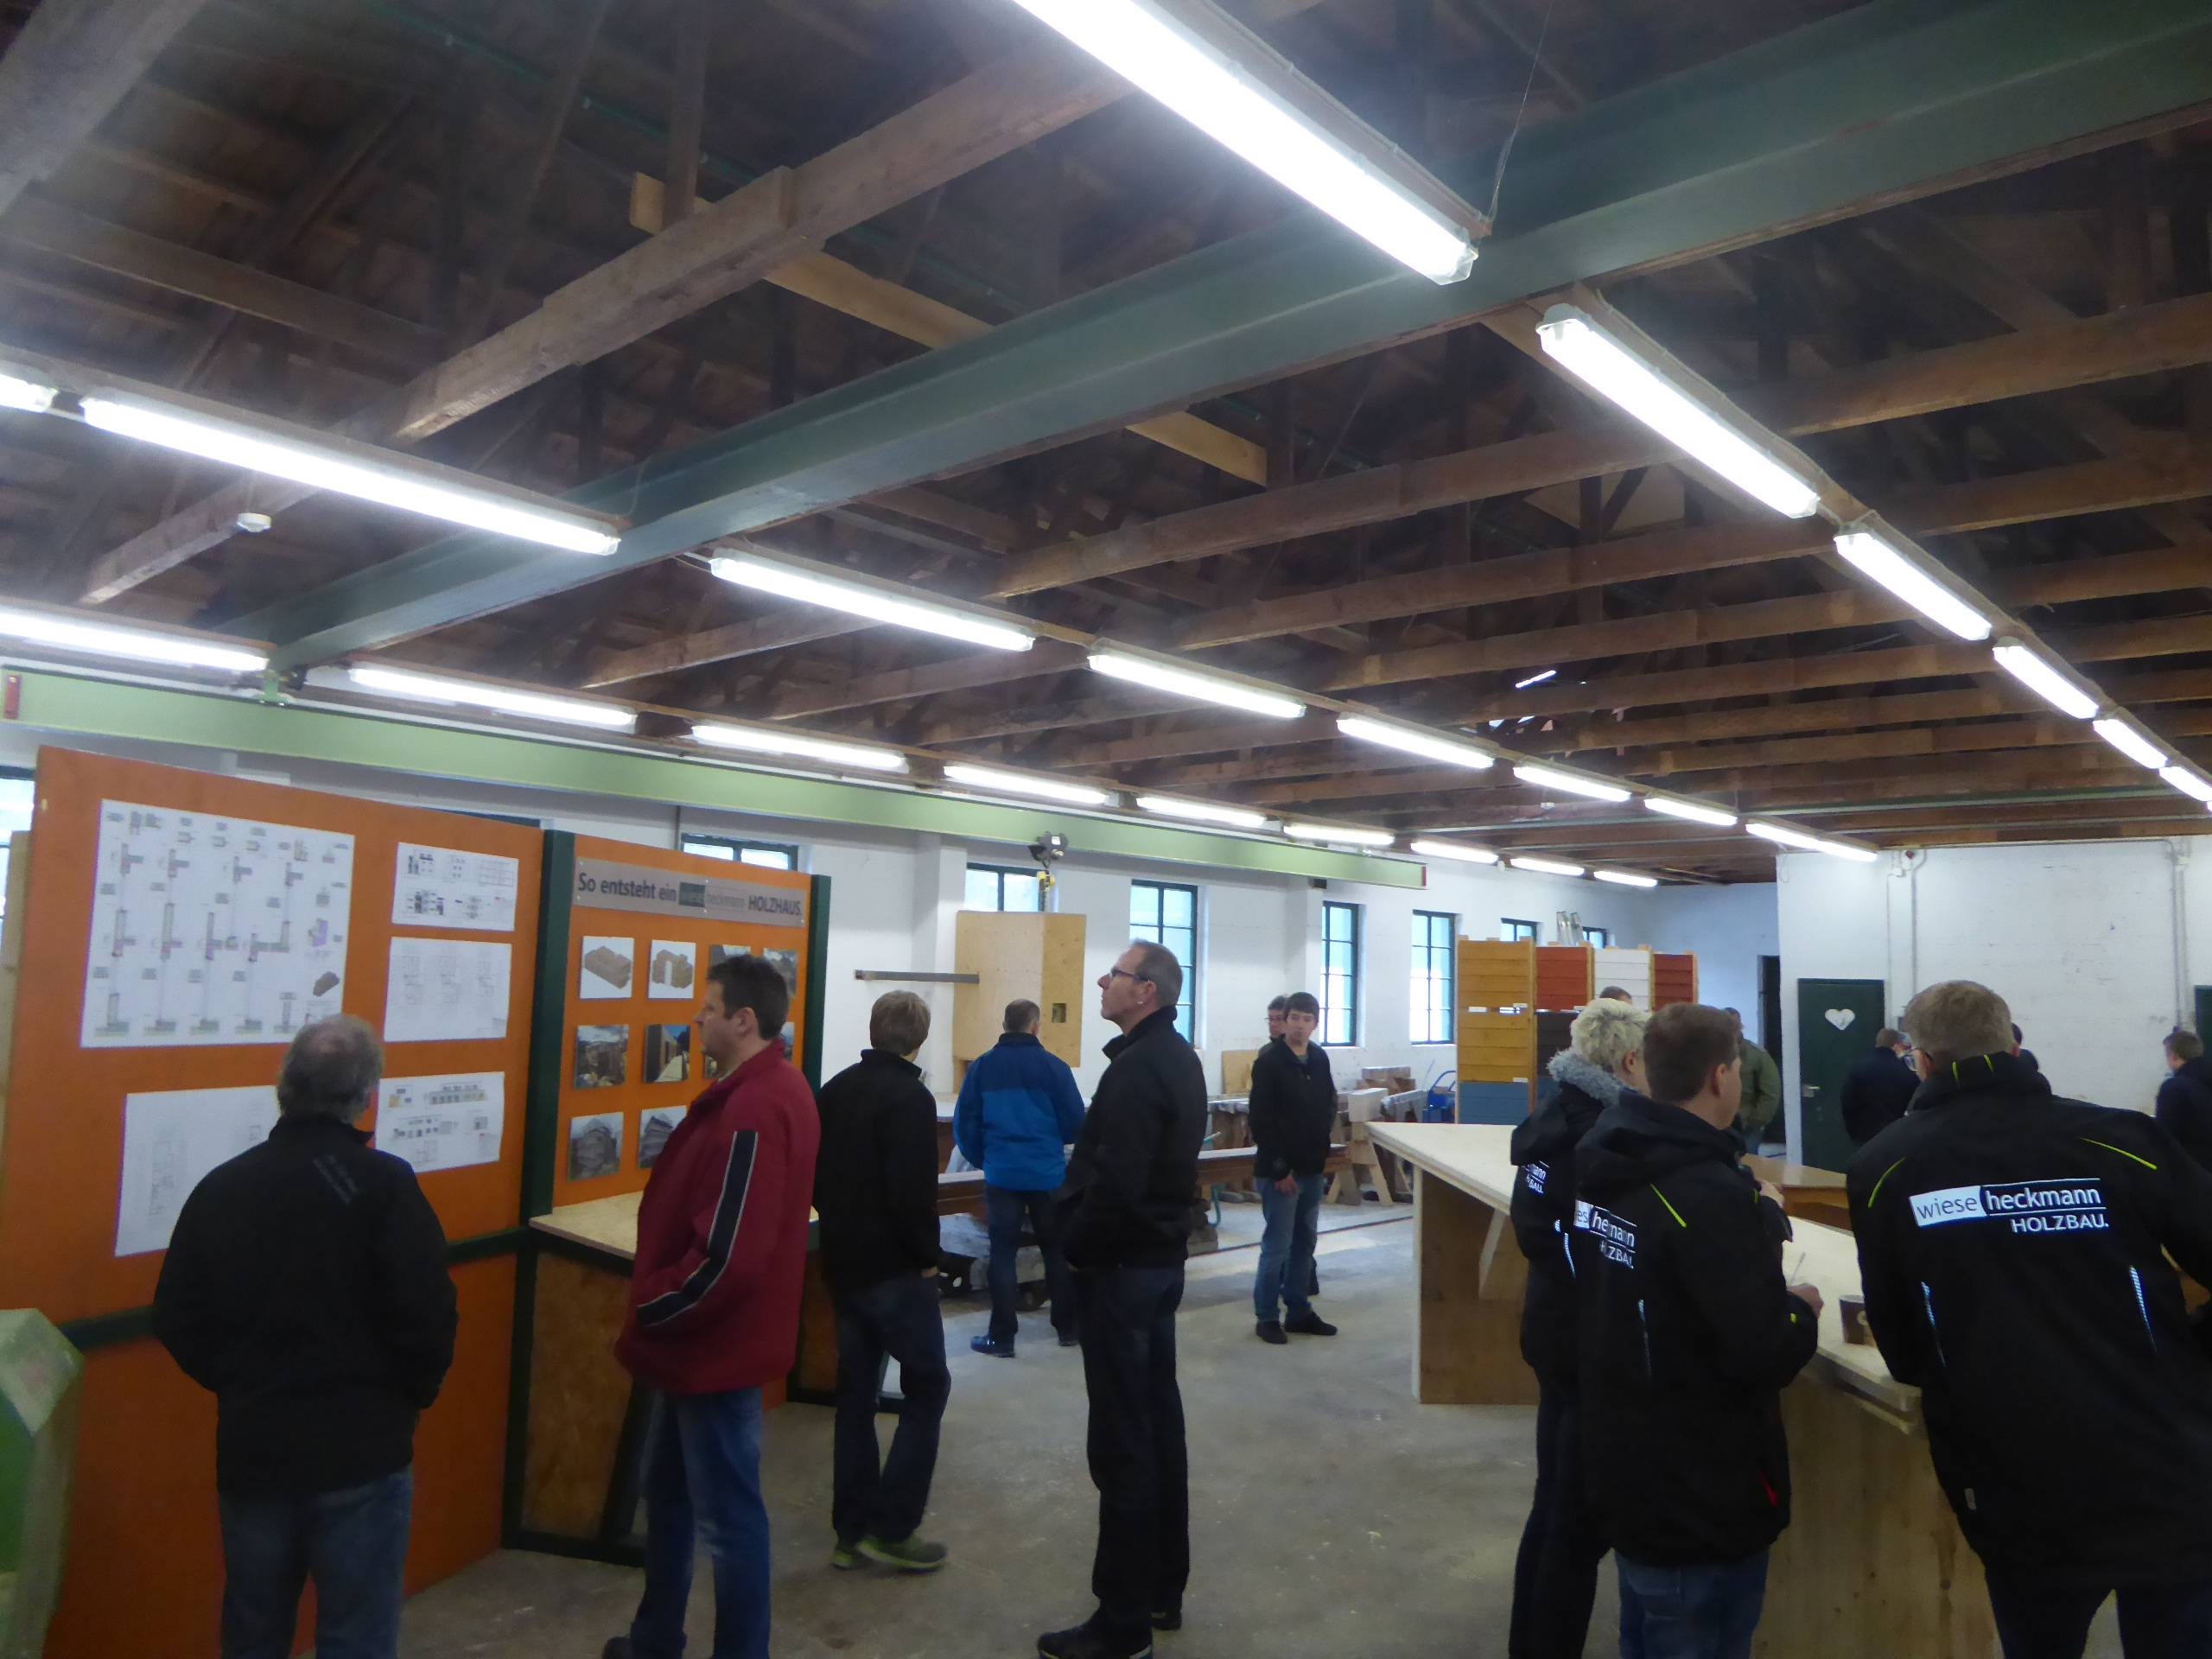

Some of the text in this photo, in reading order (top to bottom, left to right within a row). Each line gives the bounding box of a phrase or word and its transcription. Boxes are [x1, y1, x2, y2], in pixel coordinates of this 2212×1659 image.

[578, 872, 596, 893] So
[601, 880, 656, 899] entsteht
[658, 883, 677, 901] ein
[1916, 1186, 2101, 1219] wiese heckmann
[2010, 1213, 2109, 1233] HOLZBAU.
